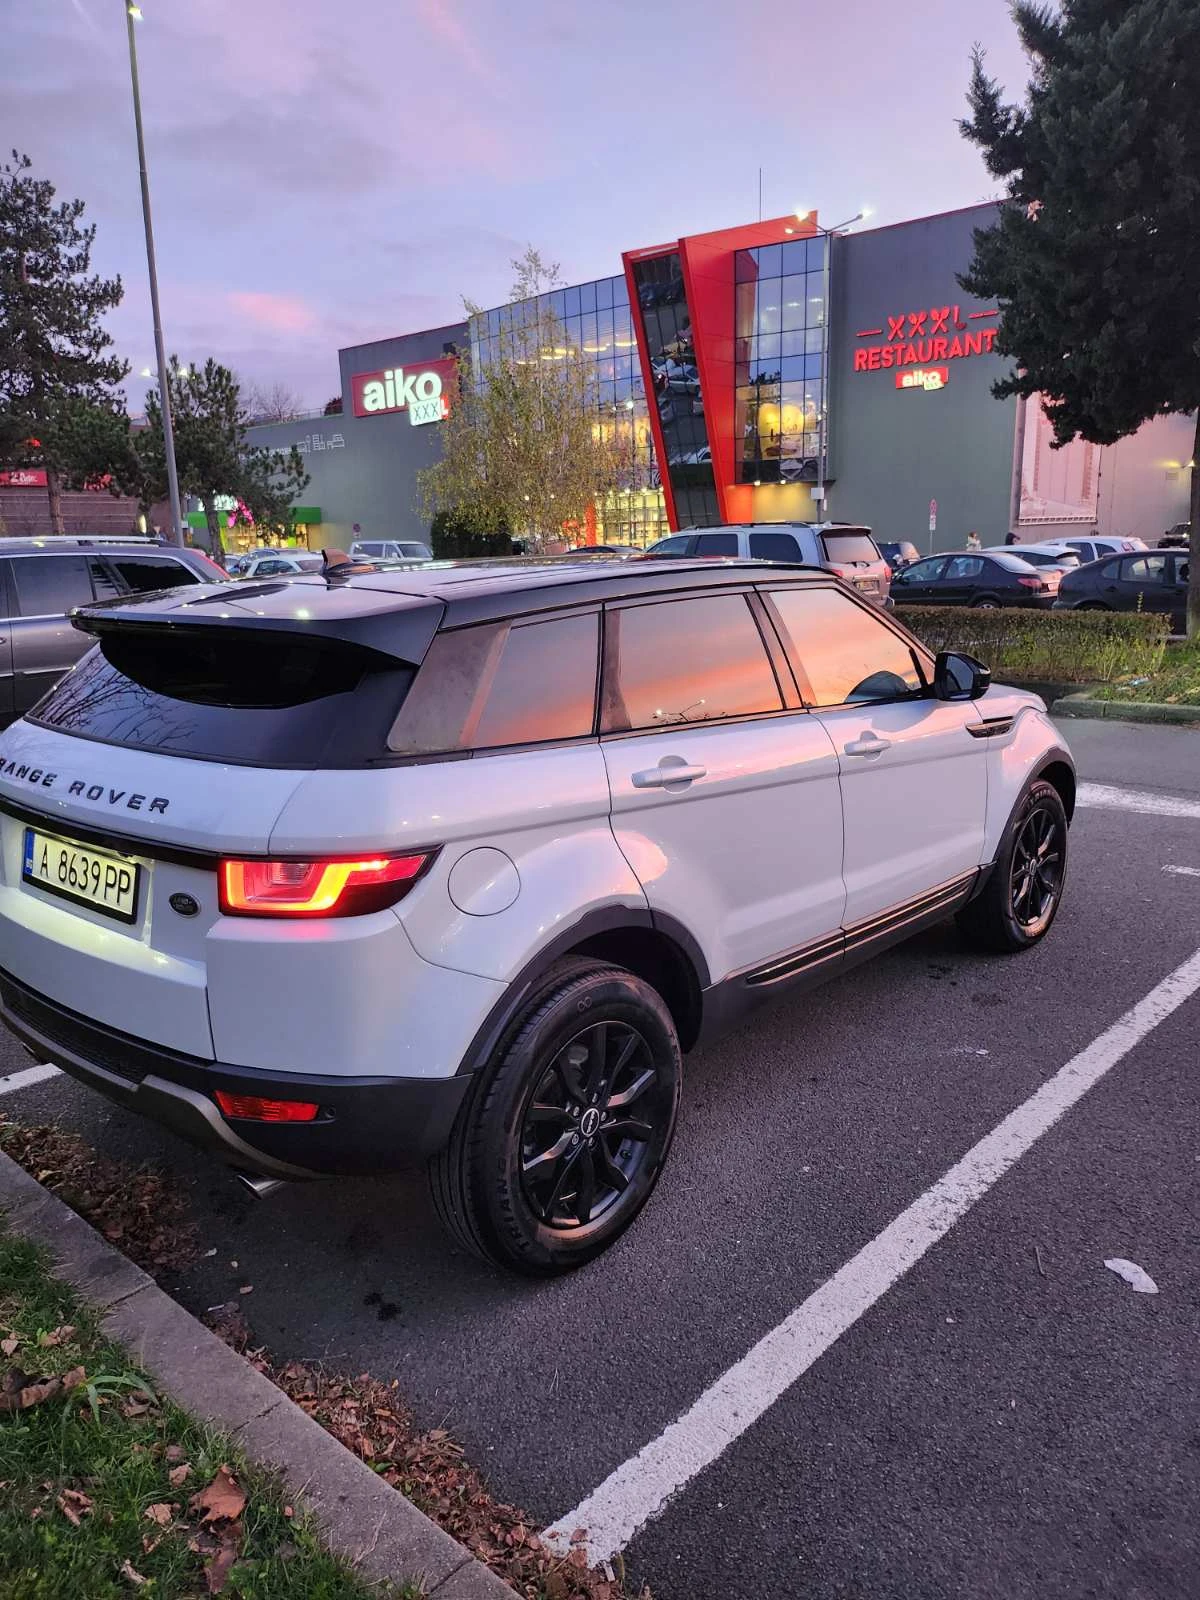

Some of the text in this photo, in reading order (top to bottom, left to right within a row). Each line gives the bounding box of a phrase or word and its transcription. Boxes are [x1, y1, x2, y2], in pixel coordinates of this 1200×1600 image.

[887, 305, 967, 341] XXXL
[854, 328, 998, 371] RESTAURANT
[363, 368, 442, 411] aiko
[902, 369, 941, 387] aiko
[68, 780, 170, 814] ROVER
[40, 843, 49, 878] A
